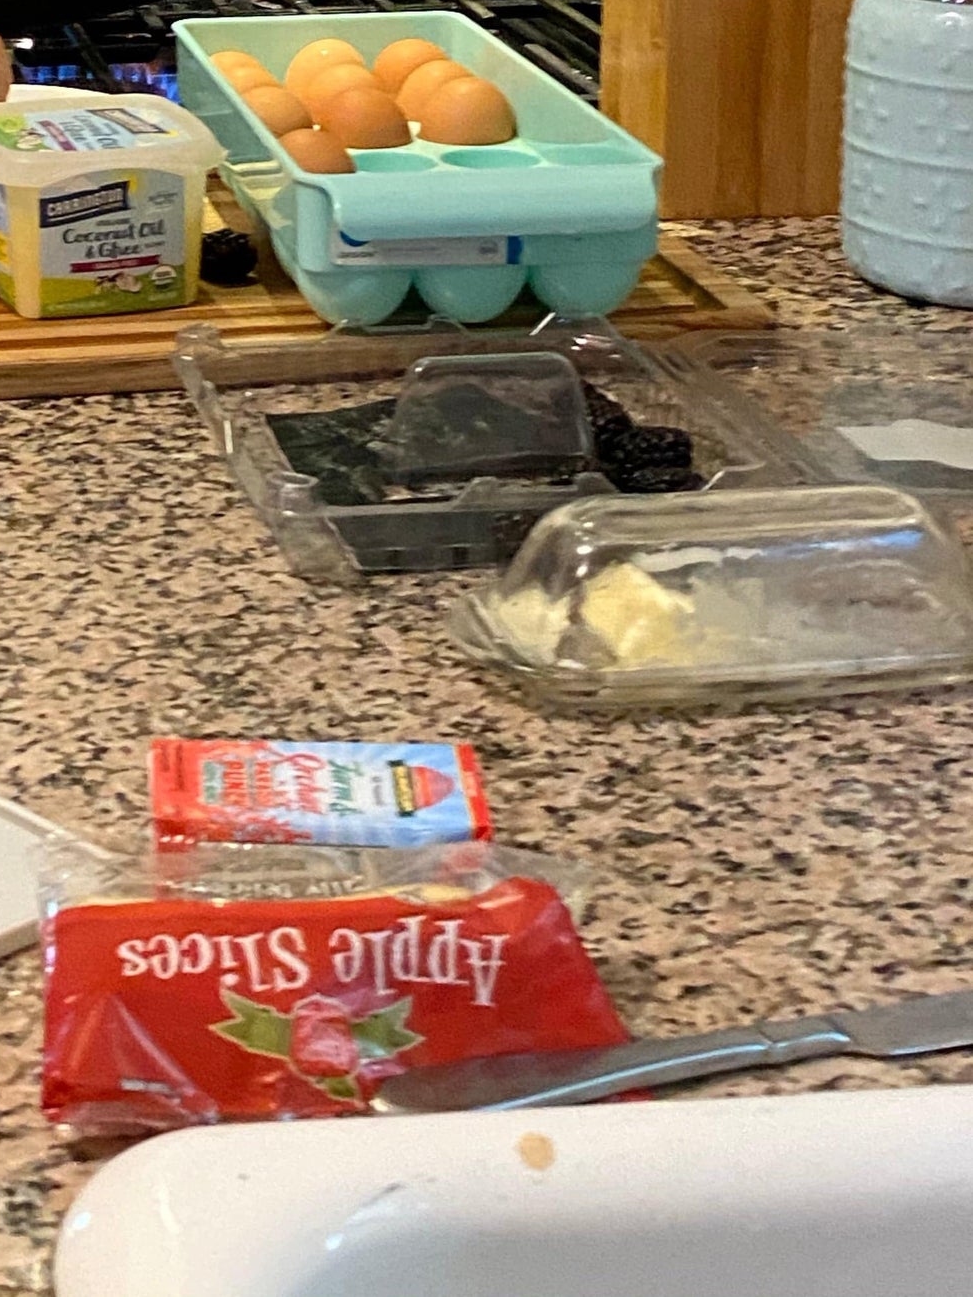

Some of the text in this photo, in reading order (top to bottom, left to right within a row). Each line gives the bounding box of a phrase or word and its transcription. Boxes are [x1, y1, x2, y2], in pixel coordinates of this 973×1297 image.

[62, 218, 165, 245] Coconut Oil
[97, 241, 140, 259] Ghee
[116, 915, 511, 1007] Apple Slices
